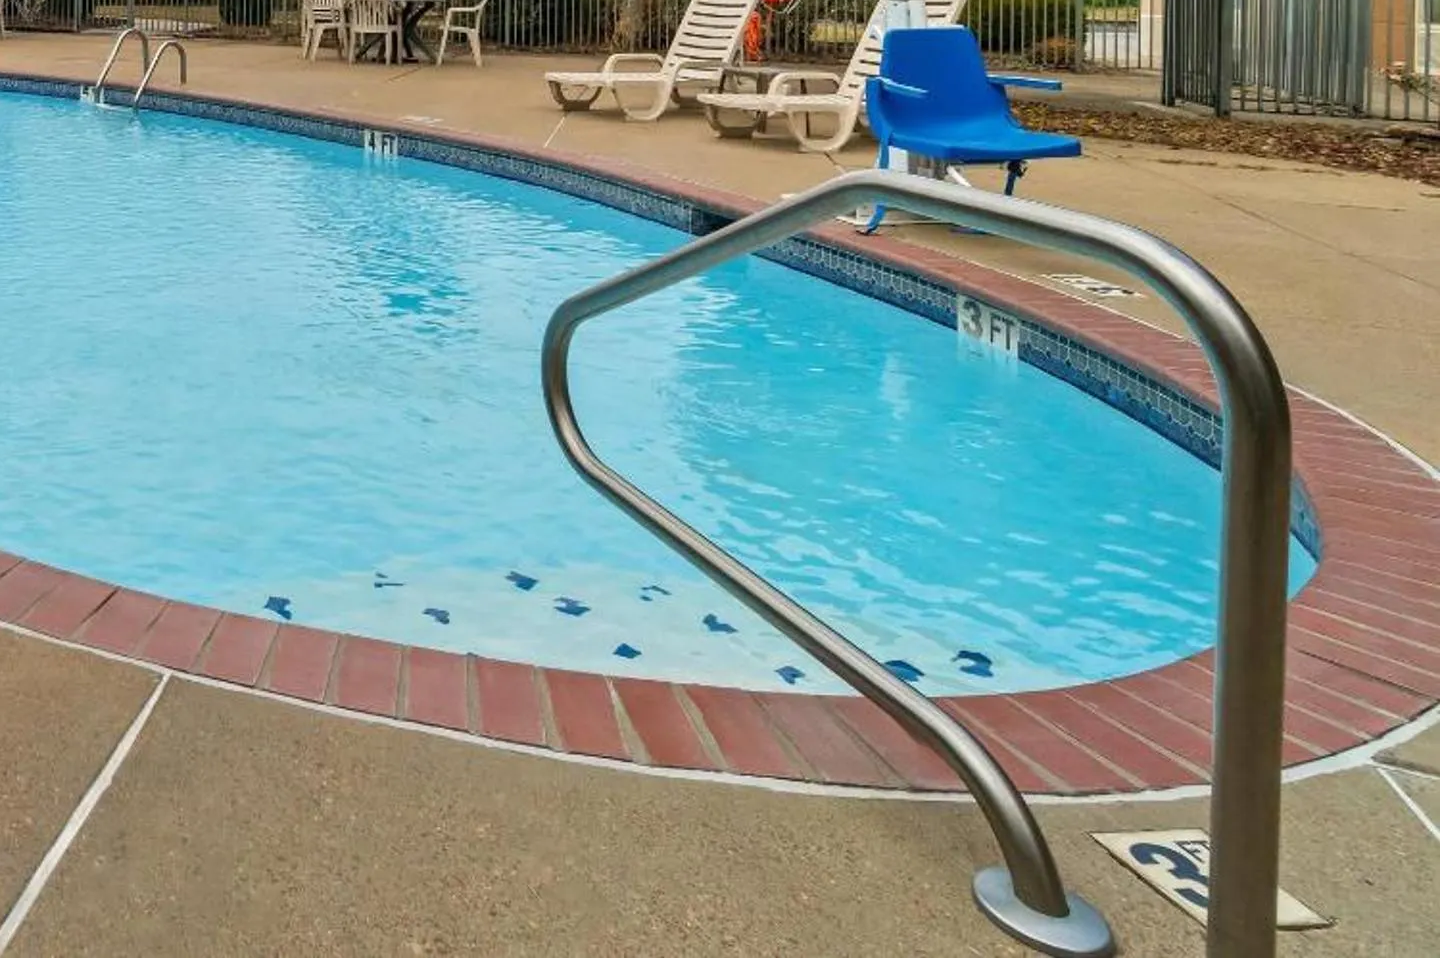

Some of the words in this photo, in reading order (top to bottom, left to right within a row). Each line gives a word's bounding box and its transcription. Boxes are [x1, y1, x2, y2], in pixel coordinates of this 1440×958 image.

[382, 134, 396, 154] FT
[962, 300, 984, 339] 3
[989, 312, 1015, 351] FT
[1129, 843, 1209, 908] 3
